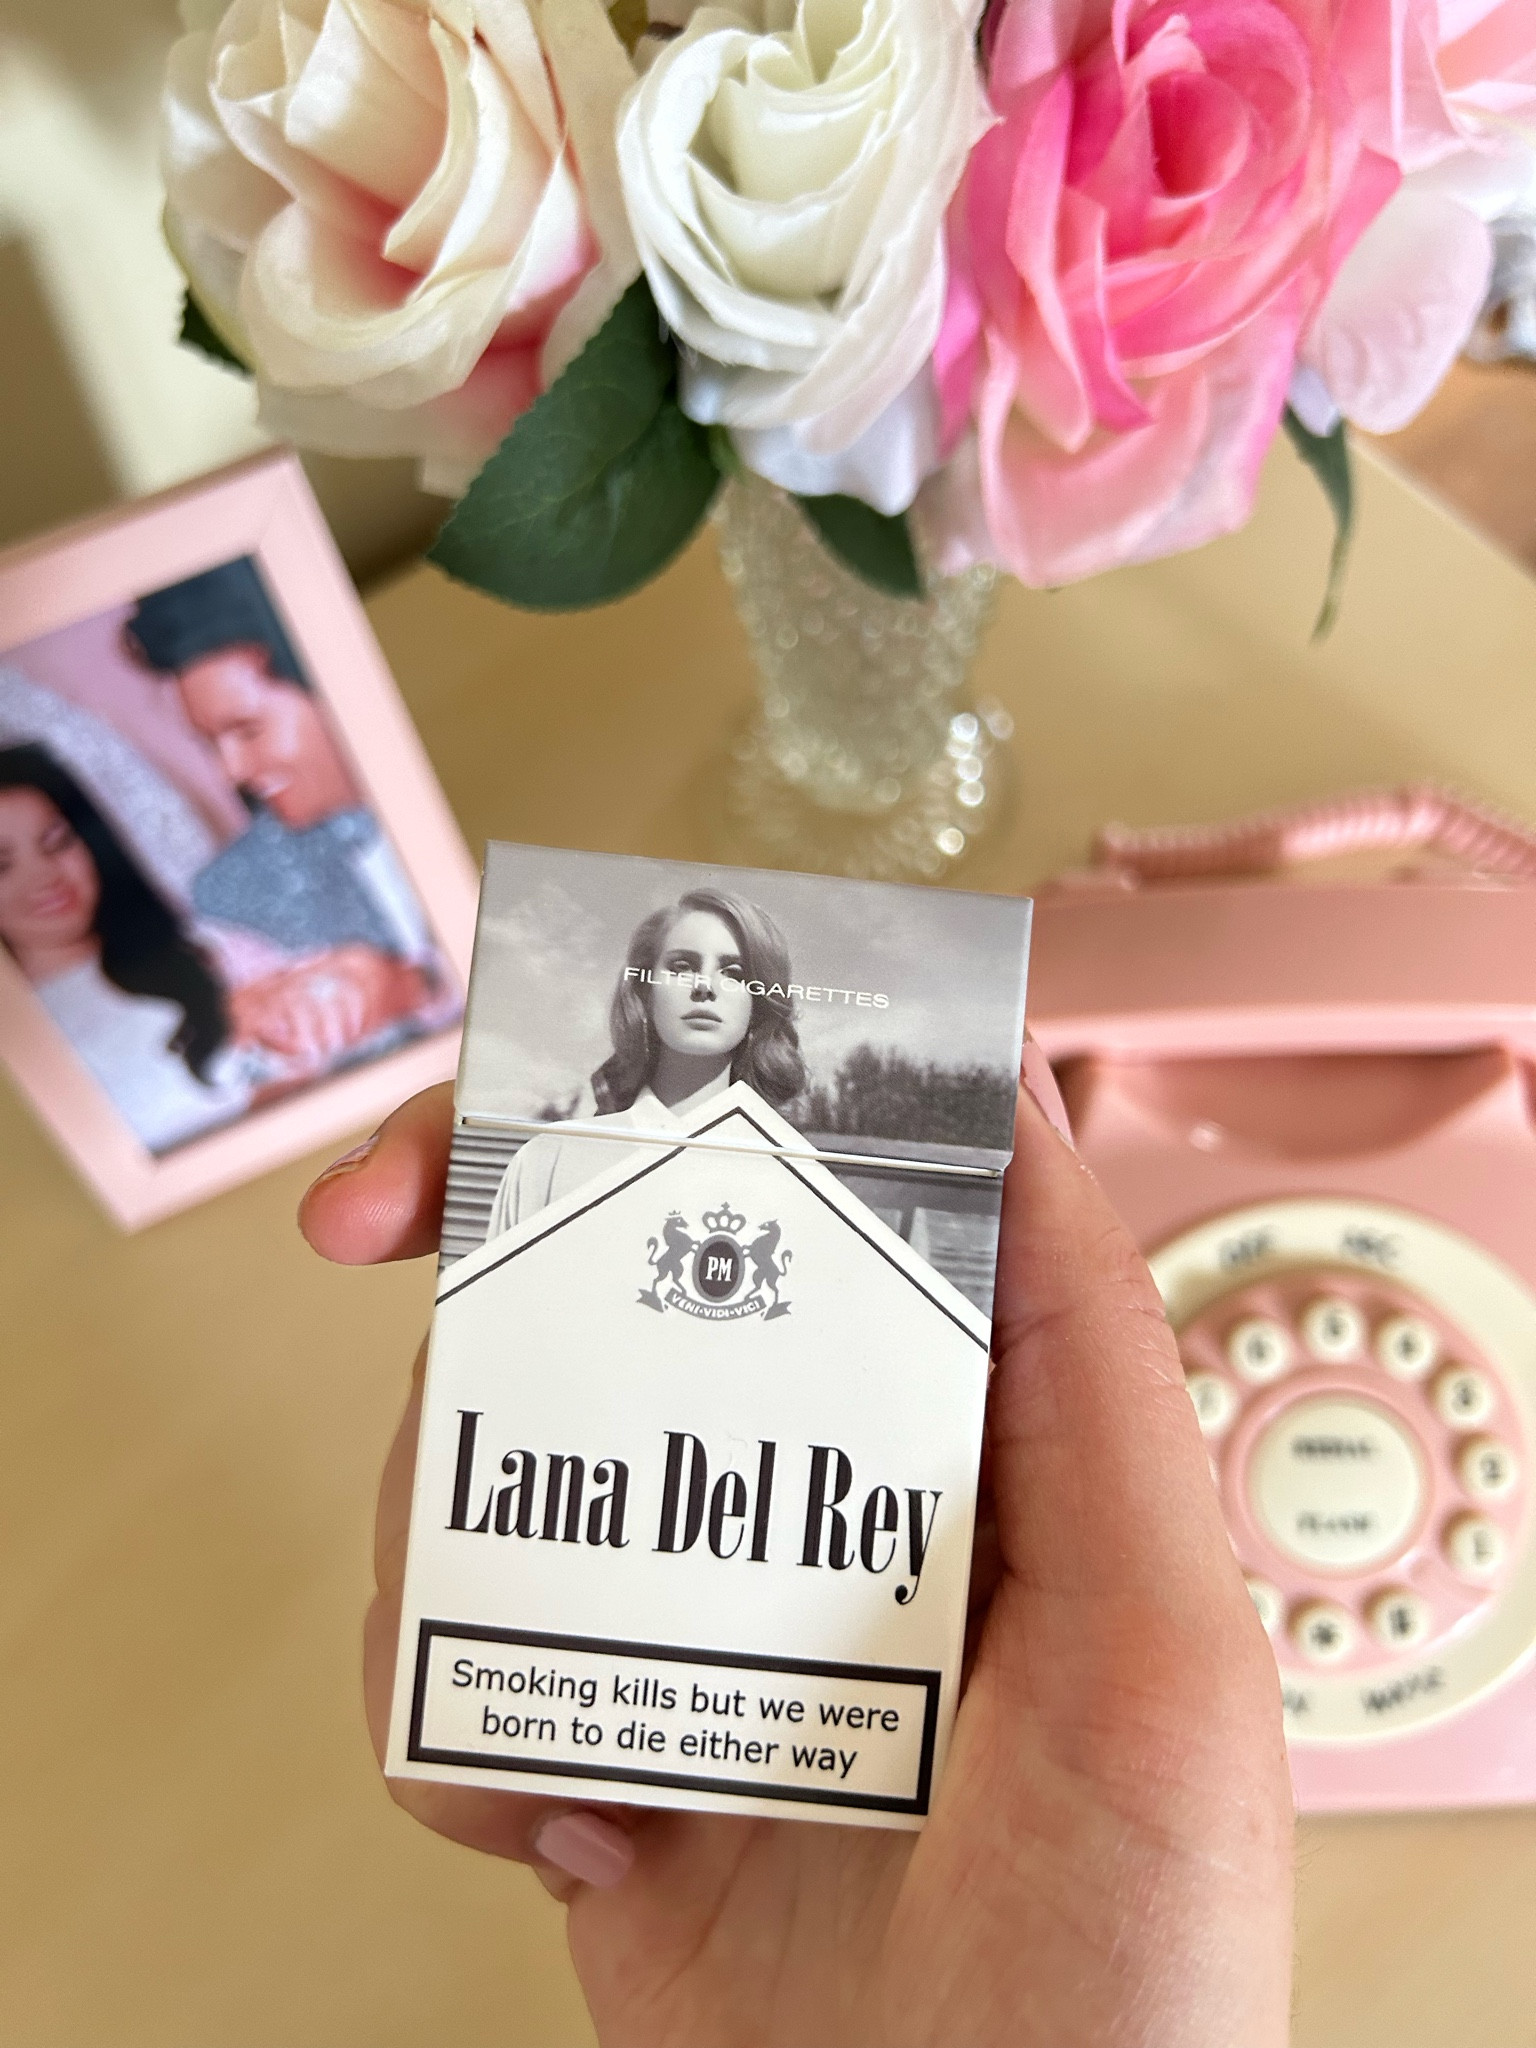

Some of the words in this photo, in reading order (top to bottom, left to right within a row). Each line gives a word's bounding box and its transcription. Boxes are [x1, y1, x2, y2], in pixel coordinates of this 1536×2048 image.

[623, 966, 712, 990] FILTER
[720, 978, 890, 1009] CIGARETTES
[705, 1256, 733, 1282] PM
[445, 1410, 630, 1549] Lana
[652, 1431, 777, 1563] Del
[797, 1445, 943, 1606] Rey
[452, 1658, 598, 1709] Smoking
[612, 1674, 677, 1710] kills
[690, 1683, 747, 1718] but
[759, 1697, 805, 1724] we
[818, 1703, 900, 1733] were
[482, 1705, 556, 1742] born
[571, 1716, 603, 1746] to
[616, 1720, 666, 1753] die
[679, 1730, 780, 1765] either
[791, 1744, 858, 1780] way
